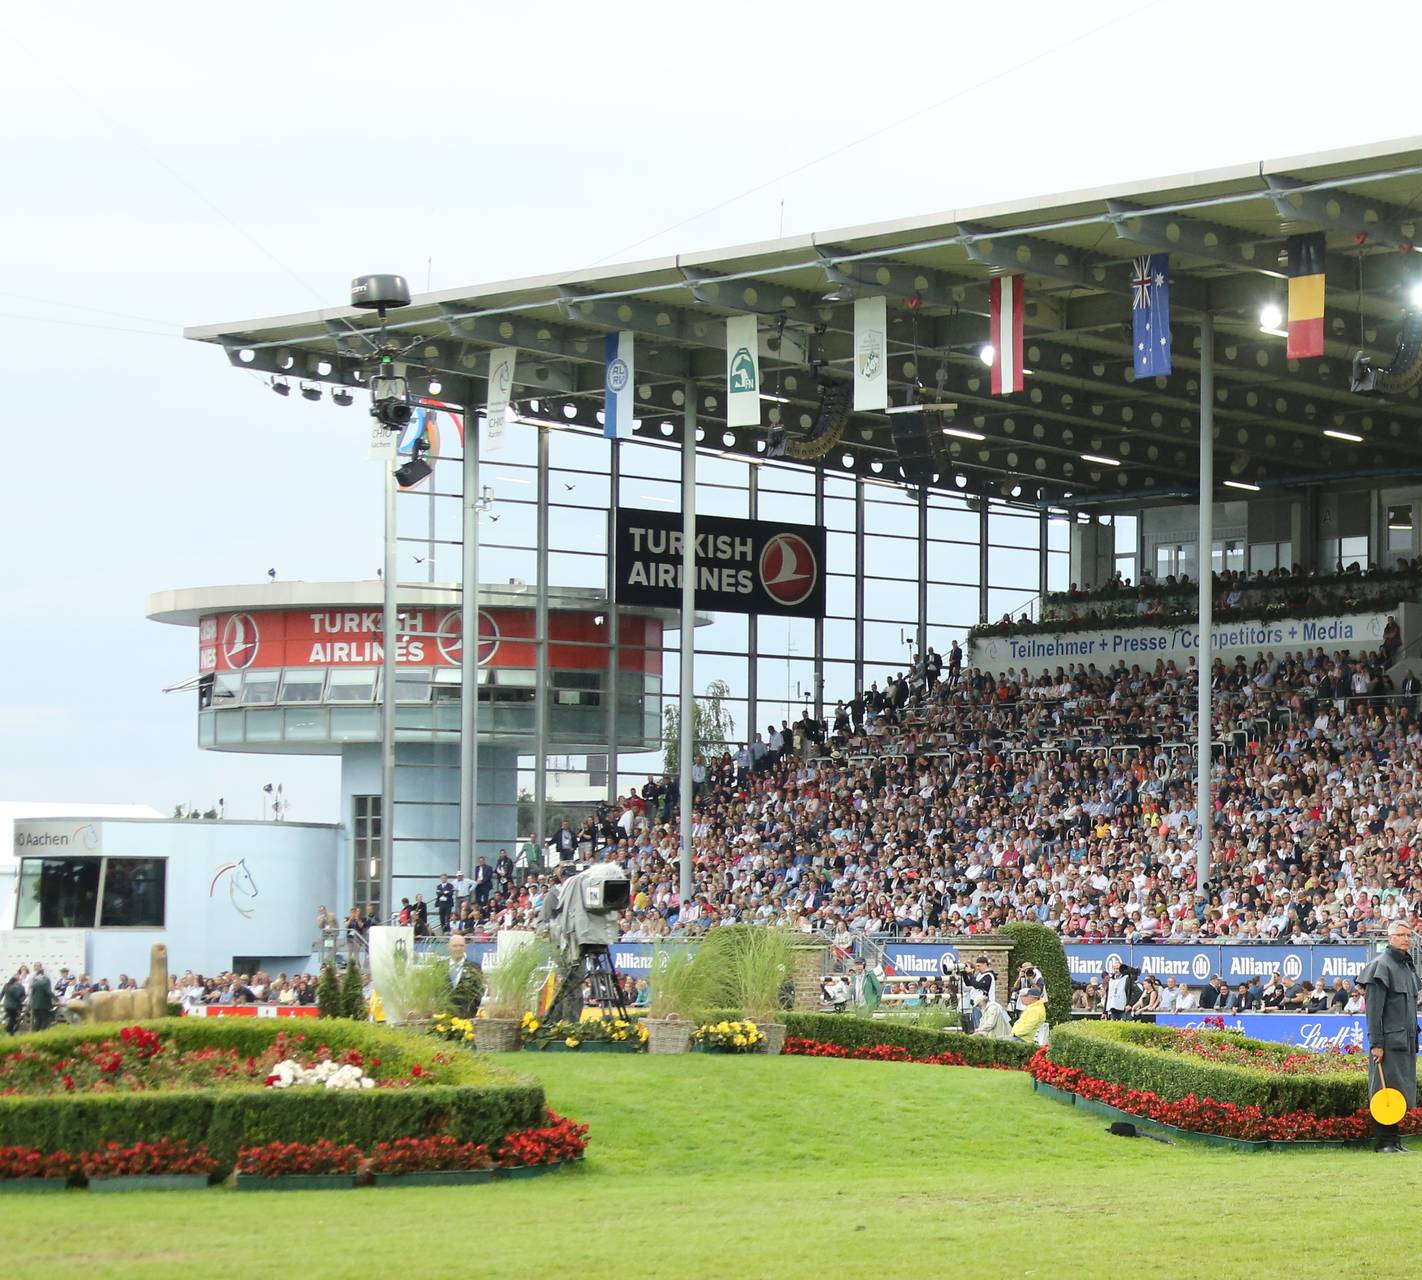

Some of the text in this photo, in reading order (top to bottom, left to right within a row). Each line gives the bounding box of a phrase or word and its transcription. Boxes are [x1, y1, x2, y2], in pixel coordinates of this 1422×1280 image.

[629, 527, 753, 562] TURKISH
[1009, 639, 1095, 659] Teilnehmer
[1113, 634, 1167, 653] Presse
[1302, 620, 1354, 641] Media
[26, 832, 69, 847] Aachen
[614, 952, 654, 969] Allianz
[894, 953, 938, 972] Allianz
[1066, 955, 1103, 974] llianz
[1140, 956, 1190, 975] Allianz
[1230, 956, 1281, 975] Allianz
[1321, 957, 1368, 976] Allian
[1296, 1023, 1351, 1049] Lindt
